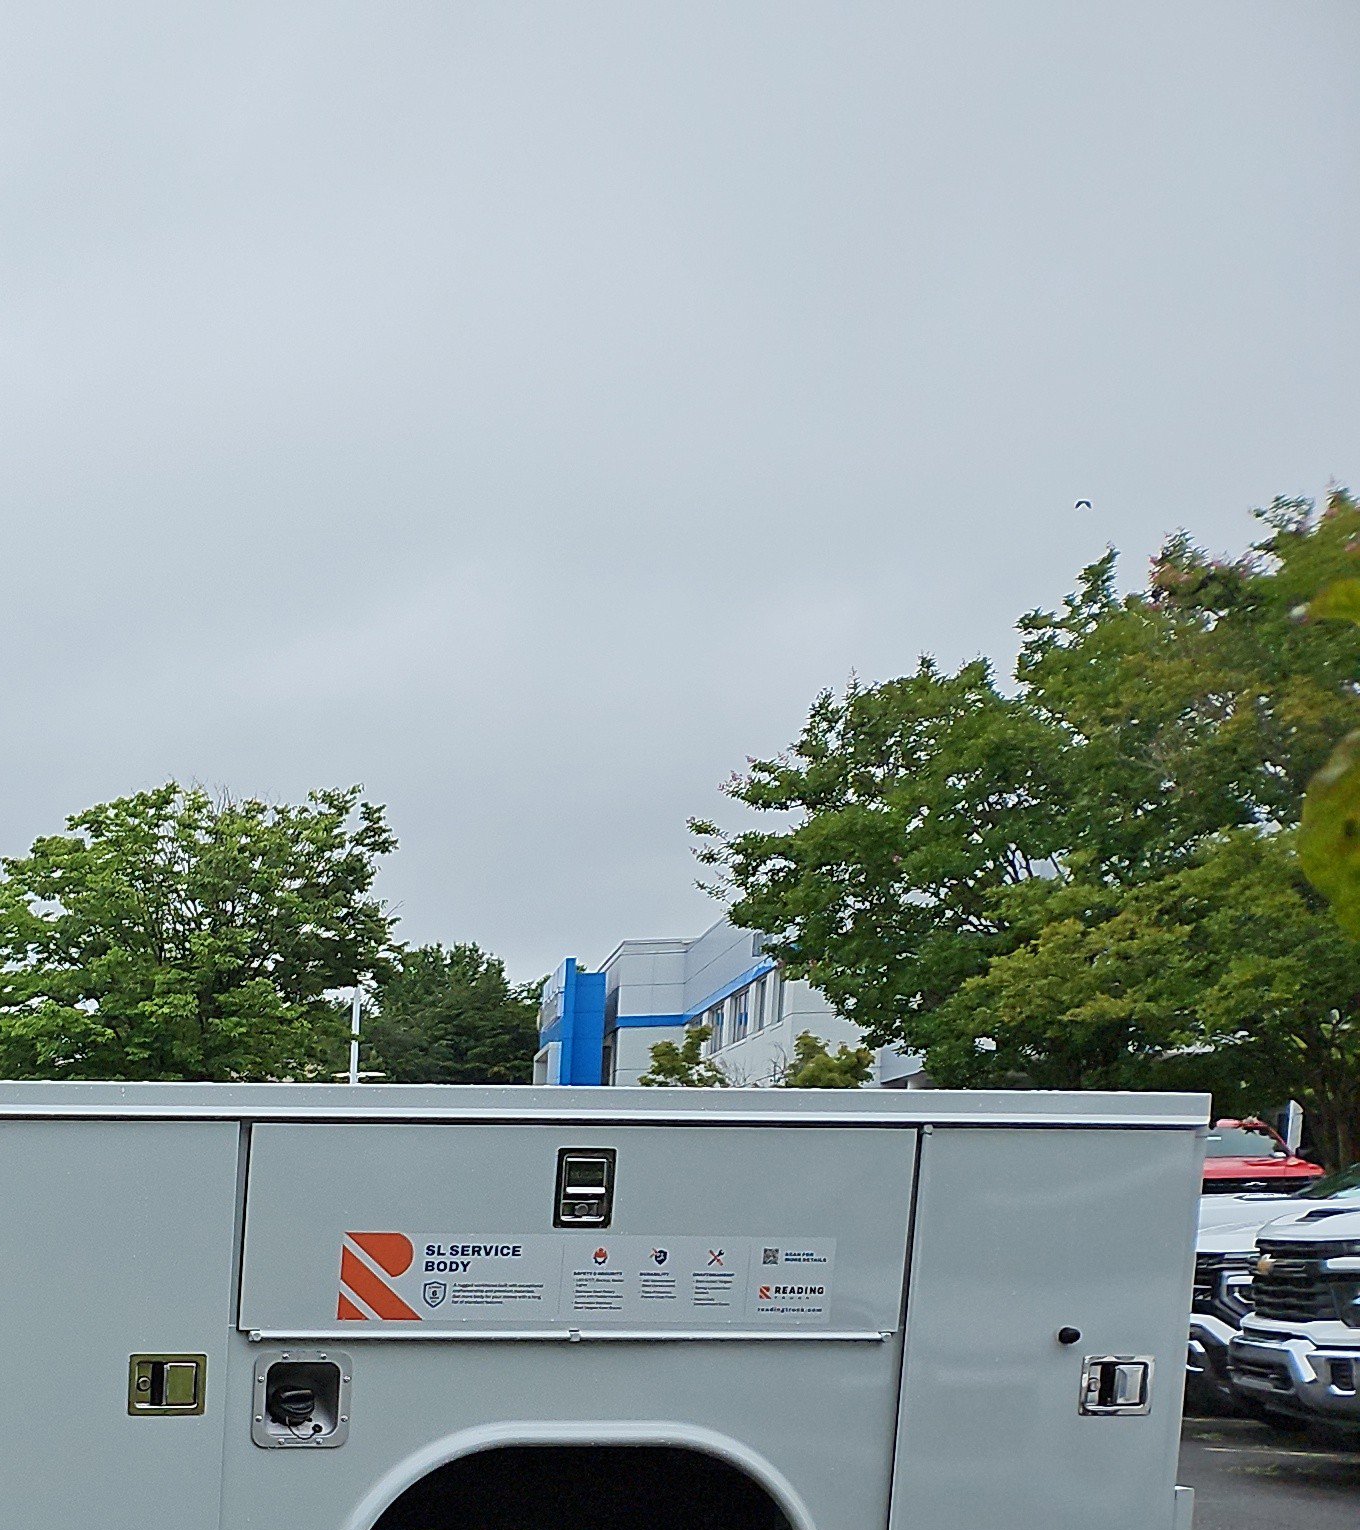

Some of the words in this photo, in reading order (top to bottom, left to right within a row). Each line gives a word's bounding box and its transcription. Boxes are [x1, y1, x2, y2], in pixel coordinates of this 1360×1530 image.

[425, 1244, 446, 1257] SL
[449, 1245, 522, 1257] SERVICE
[424, 1260, 471, 1272] BODY
[774, 1286, 824, 1294] READING
